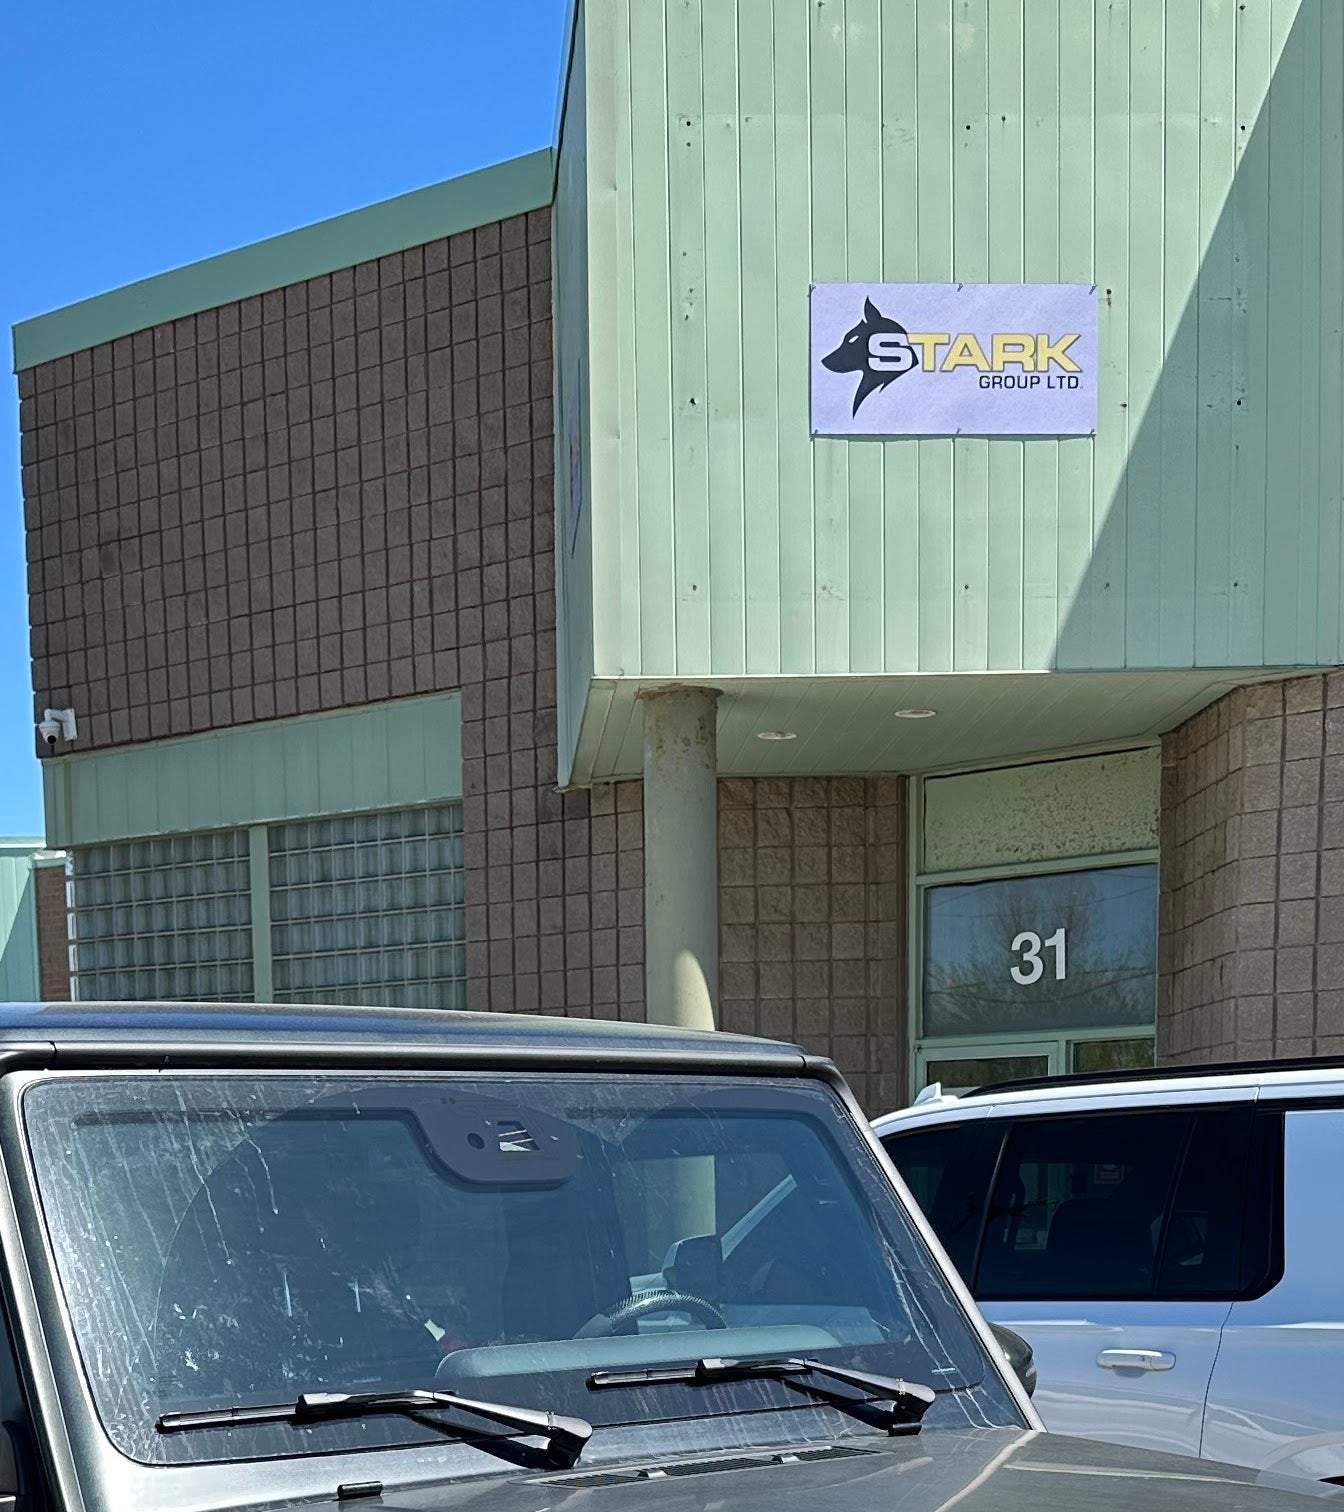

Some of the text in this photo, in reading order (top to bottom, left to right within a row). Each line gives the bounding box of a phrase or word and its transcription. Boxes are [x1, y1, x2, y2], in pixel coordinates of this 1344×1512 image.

[867, 333, 1083, 373] STARK
[979, 375, 1041, 390] GROUP
[1010, 928, 1066, 986] 31
